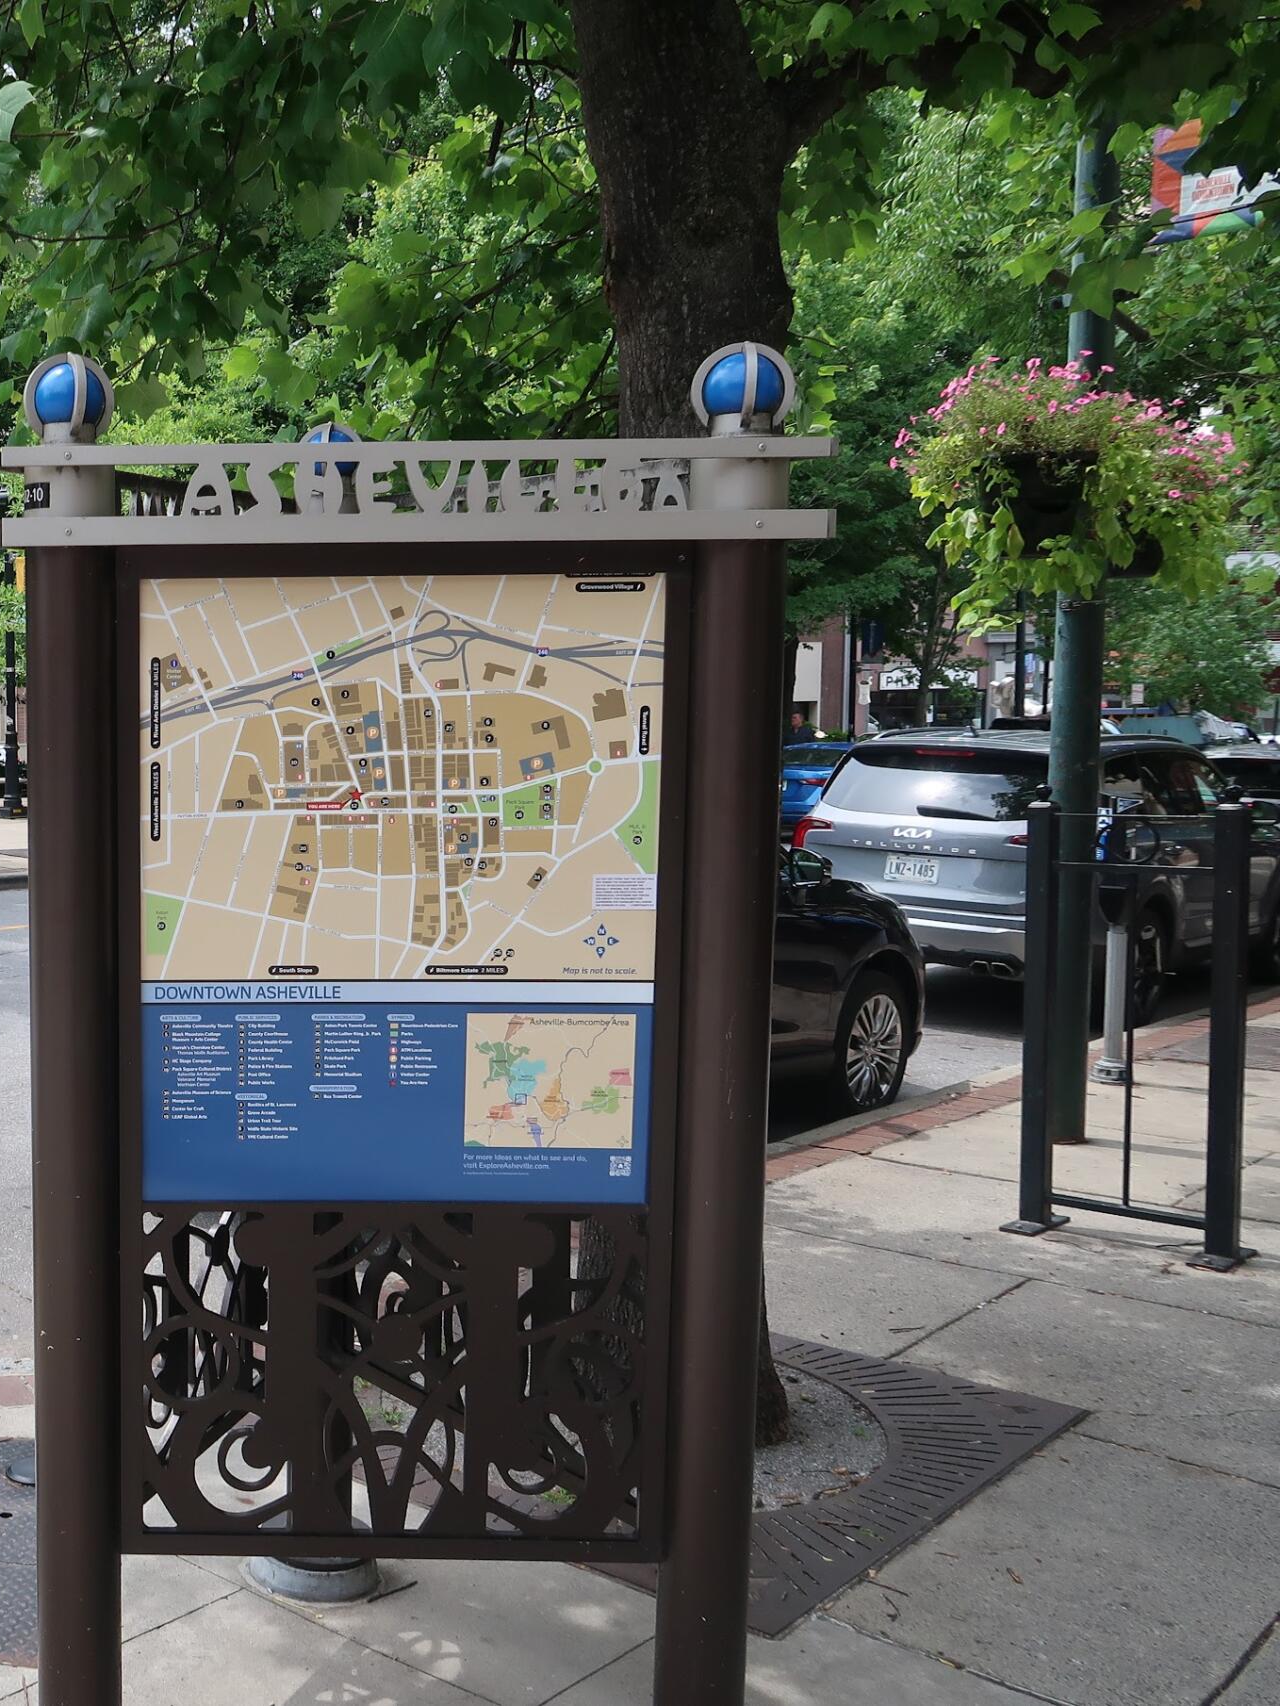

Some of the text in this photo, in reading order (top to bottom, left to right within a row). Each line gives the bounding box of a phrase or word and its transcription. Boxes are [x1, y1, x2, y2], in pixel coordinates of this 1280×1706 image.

[180, 459, 642, 515] ASHEVILLE
[614, 583, 634, 591] Village
[893, 826, 933, 840] KIA
[852, 838, 977, 855] TELLURIDE
[563, 967, 580, 976] Map
[581, 967, 588, 975] is
[154, 985, 341, 1000] DOWNTOWN ASHEVILLE
[611, 1018, 630, 1026] Area
[577, 1155, 588, 1163] do,
